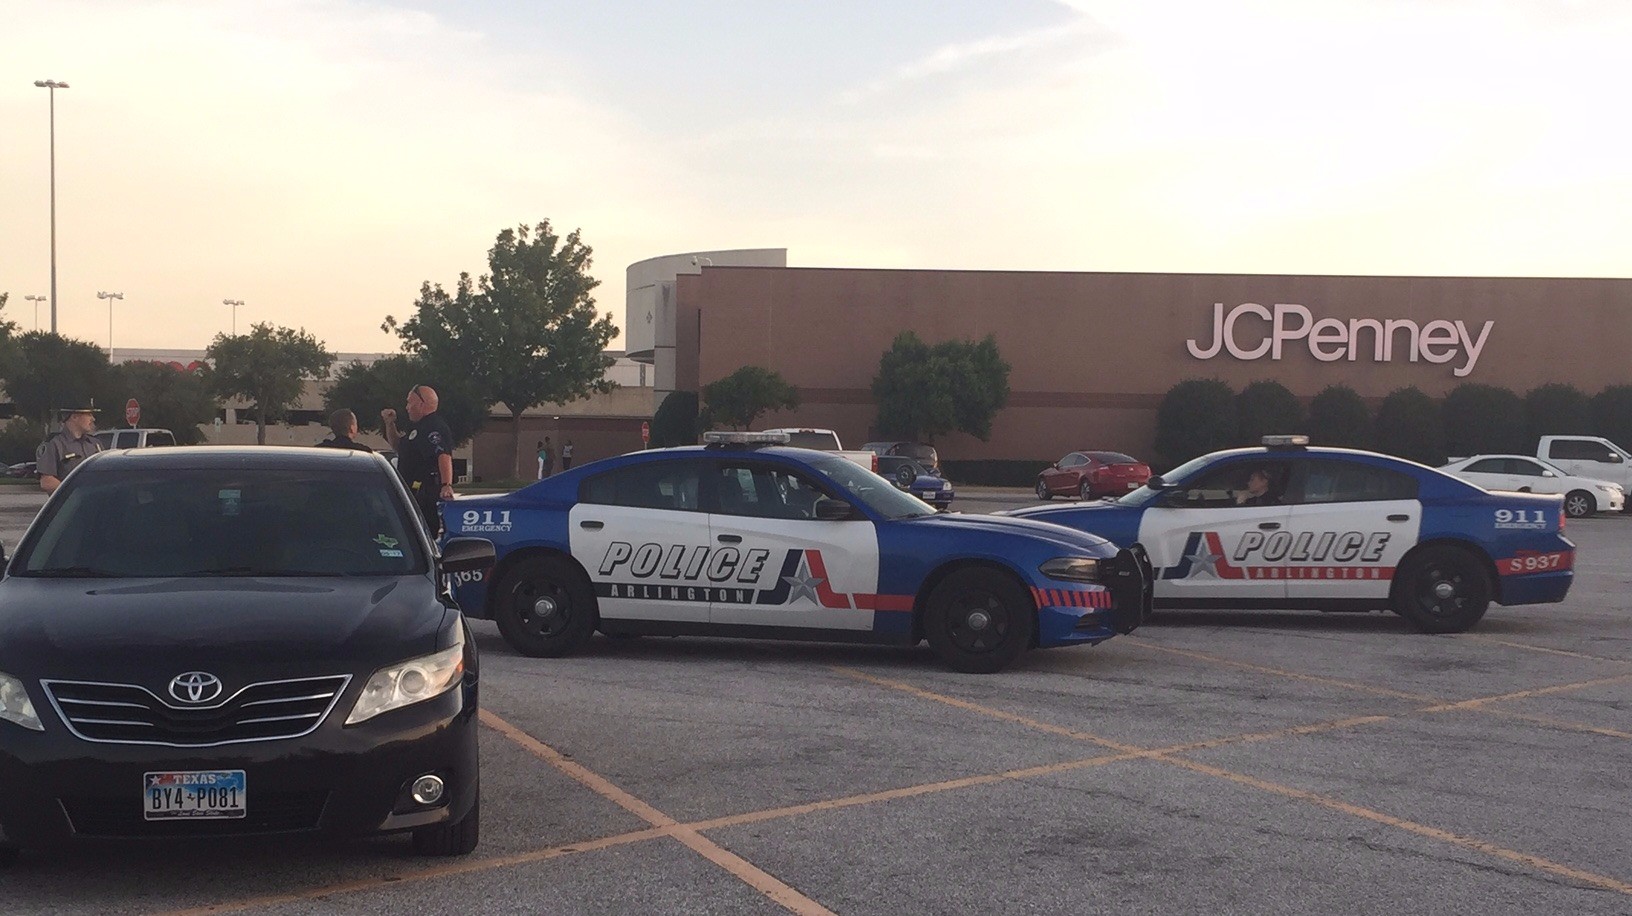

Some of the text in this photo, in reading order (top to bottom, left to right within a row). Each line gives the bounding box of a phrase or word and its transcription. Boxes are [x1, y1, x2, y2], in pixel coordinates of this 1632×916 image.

[1187, 303, 1495, 377] JCPenney
[463, 510, 512, 525] 911
[1494, 509, 1547, 523] 911
[1233, 531, 1391, 562] POLICE
[598, 541, 770, 583] POLICE
[1509, 554, 1561, 572] S 937
[1256, 567, 1380, 579] ARLINGTON
[611, 584, 744, 602] ARLINGTON
[173, 774, 217, 785] TEXAS
